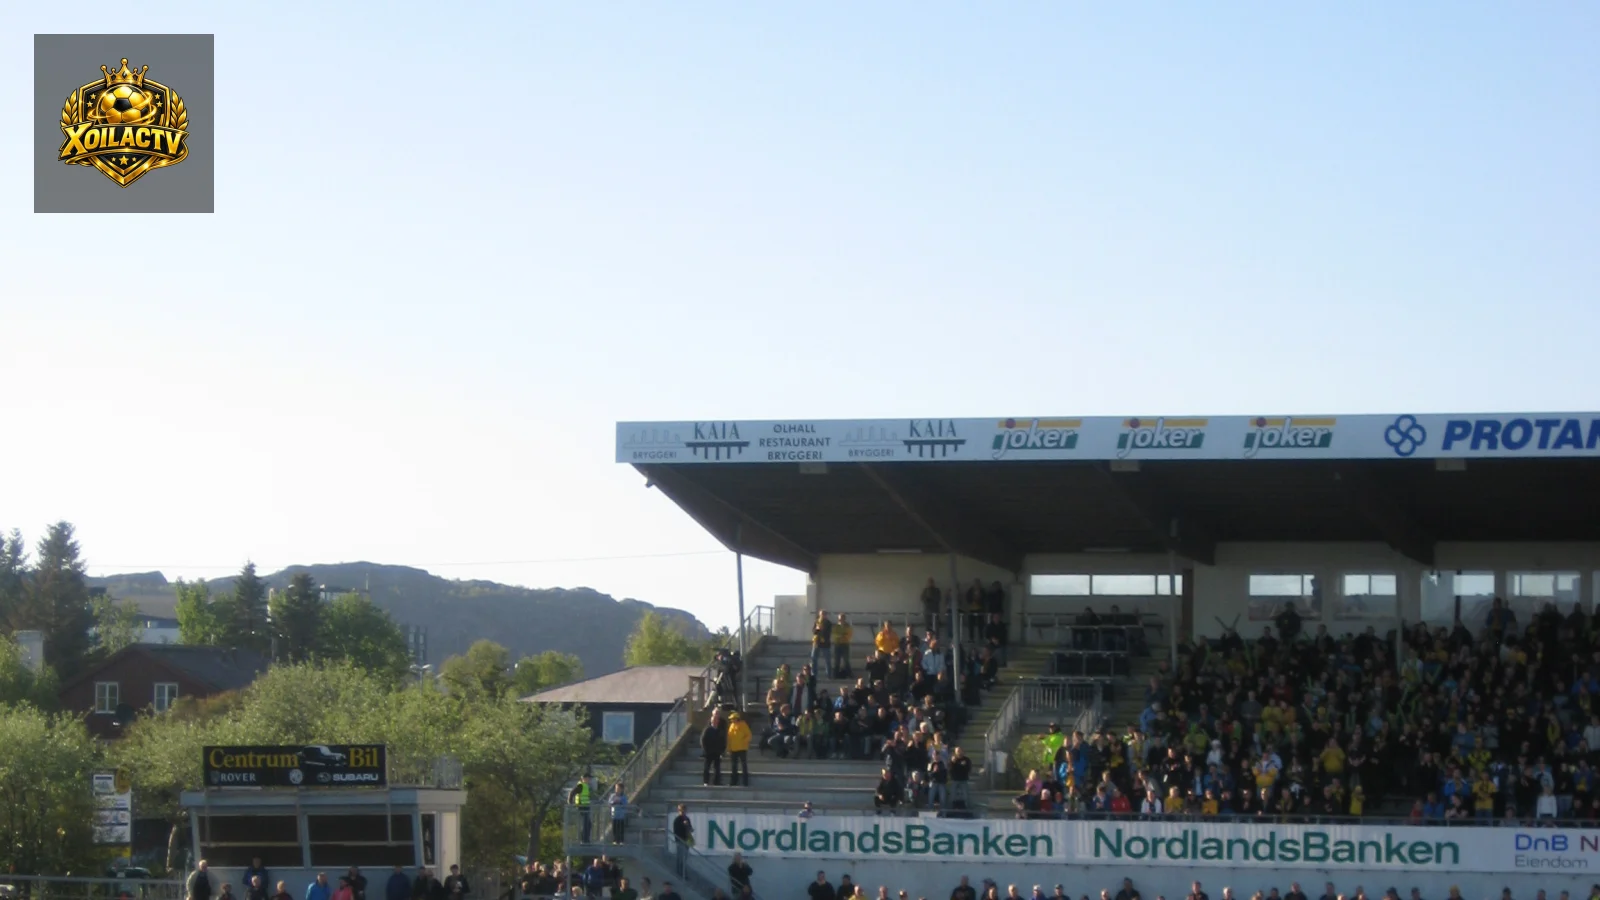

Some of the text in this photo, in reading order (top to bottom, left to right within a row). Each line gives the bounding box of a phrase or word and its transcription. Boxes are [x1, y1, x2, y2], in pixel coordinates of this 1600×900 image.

[694, 422, 740, 440] KAIA
[909, 420, 957, 438] KAIA
[1244, 416, 1332, 459] joker
[759, 437, 831, 448] RESTAURANT
[993, 418, 1077, 459] joker
[1117, 418, 1203, 459] joker
[632, 451, 677, 460] BRYGGERI
[767, 450, 822, 461] BRYGGERI
[848, 448, 894, 457] BRYGGERI
[209, 747, 379, 768] Centrum Bil
[221, 772, 256, 782] ROVER
[333, 773, 378, 781] SUBARU
[707, 820, 1053, 857] NordlandsBanken
[1094, 828, 1460, 865] NordlandsBanken
[1515, 834, 1569, 851] DnB
[1515, 855, 1588, 868] Eiendom
